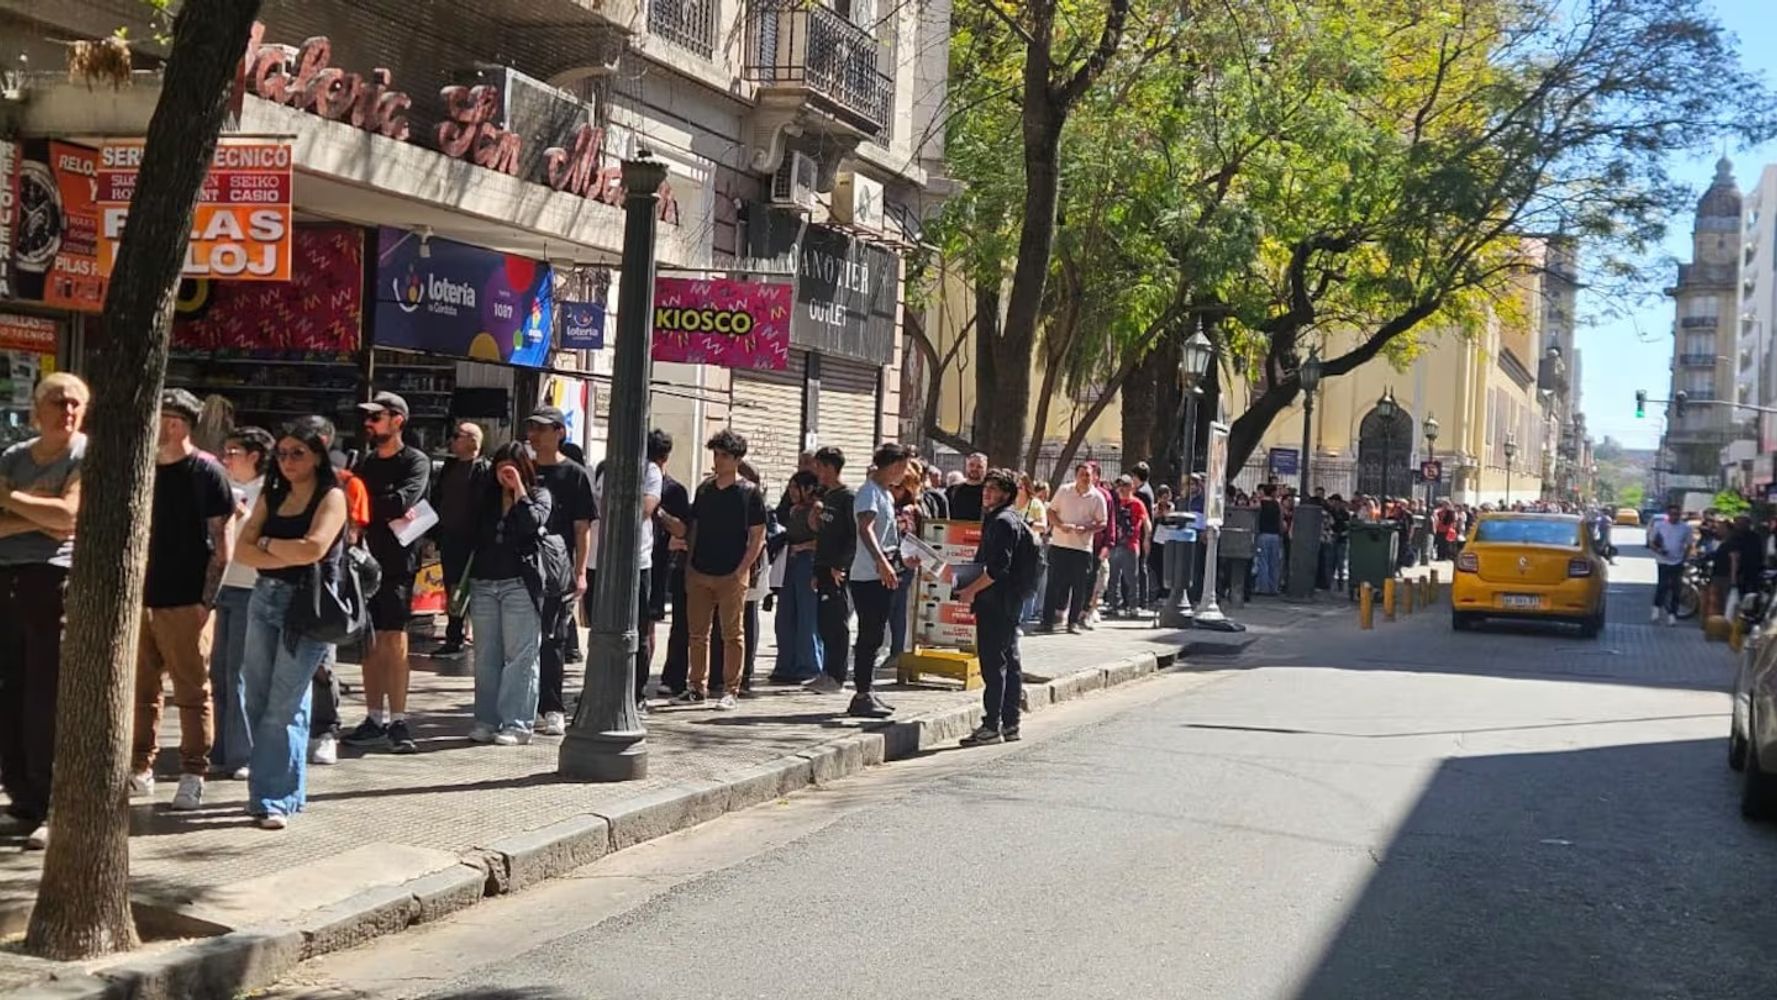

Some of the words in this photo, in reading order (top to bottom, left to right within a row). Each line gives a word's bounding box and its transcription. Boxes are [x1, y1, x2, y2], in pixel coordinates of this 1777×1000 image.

[58, 154, 97, 177] RELO
[212, 145, 288, 168] ECNICO
[230, 176, 279, 189] SEIKO
[230, 190, 279, 202] CASIO
[104, 208, 285, 241] PAS
[54, 256, 90, 276] PILAS
[655, 308, 752, 333] KIOSCO
[809, 298, 847, 328] OUTLET
